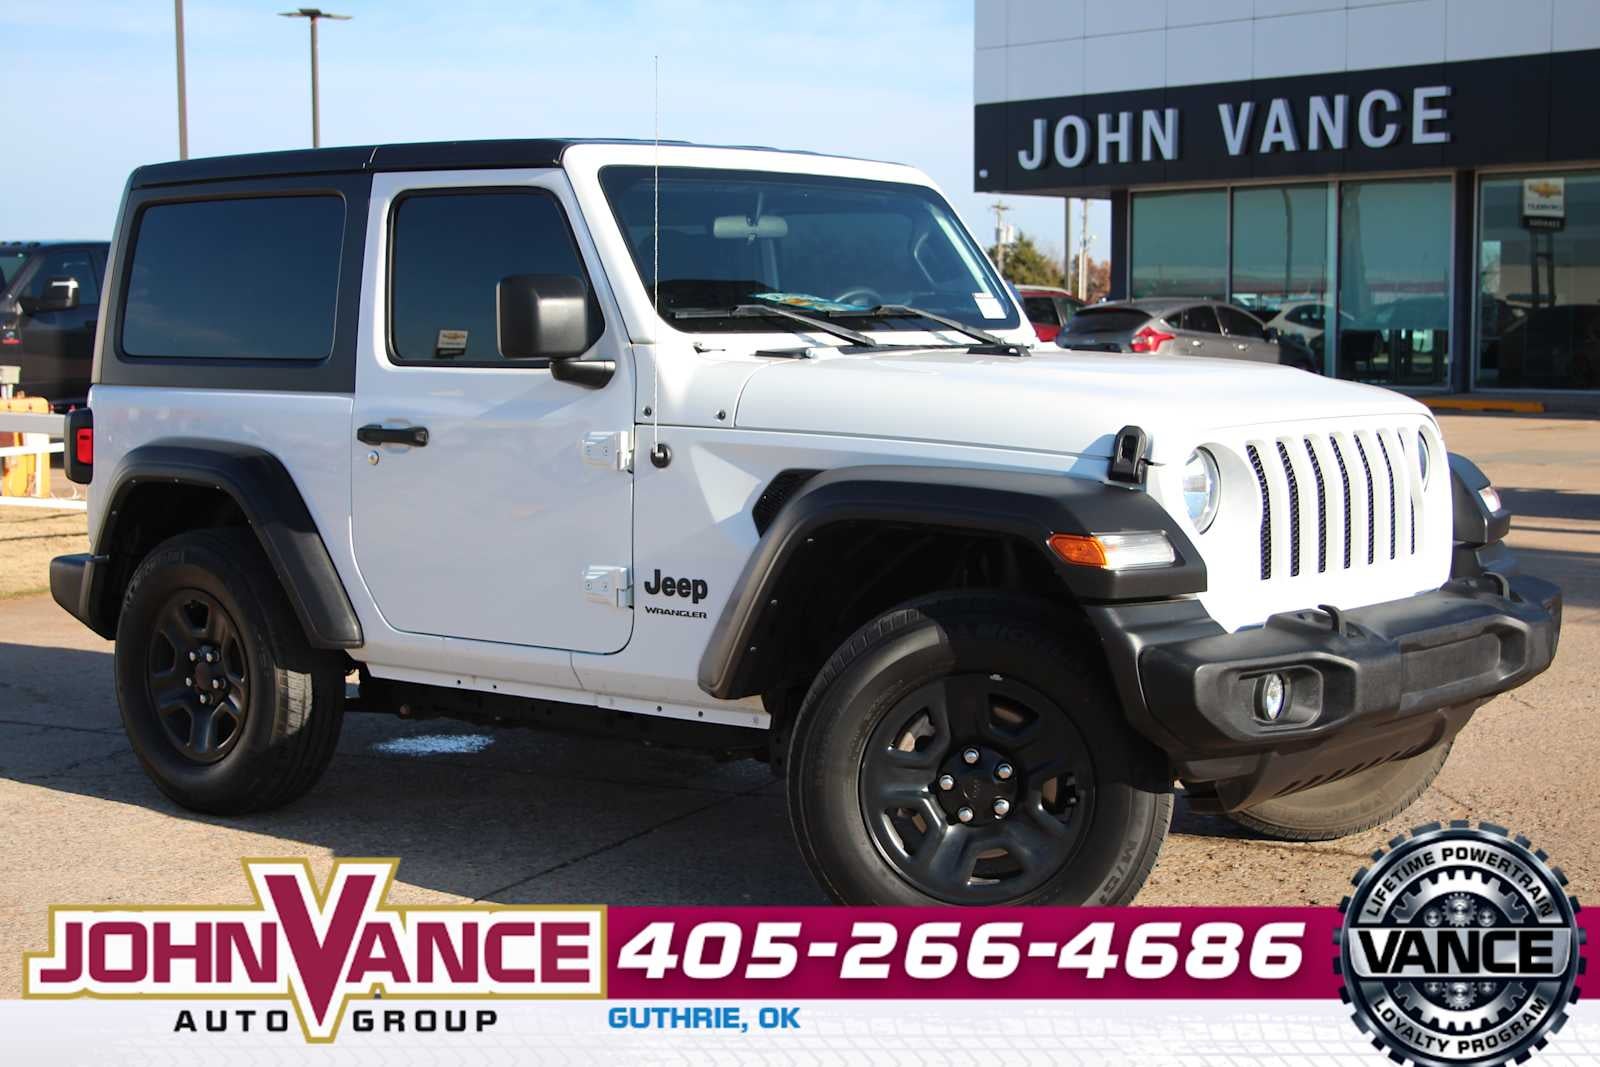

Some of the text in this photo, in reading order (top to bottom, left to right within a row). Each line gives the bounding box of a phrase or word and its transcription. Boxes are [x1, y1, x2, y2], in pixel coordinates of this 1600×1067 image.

[1018, 85, 1451, 170] JOHN VANCE
[644, 569, 708, 604] Jeep
[644, 605, 707, 619] WRANGLER
